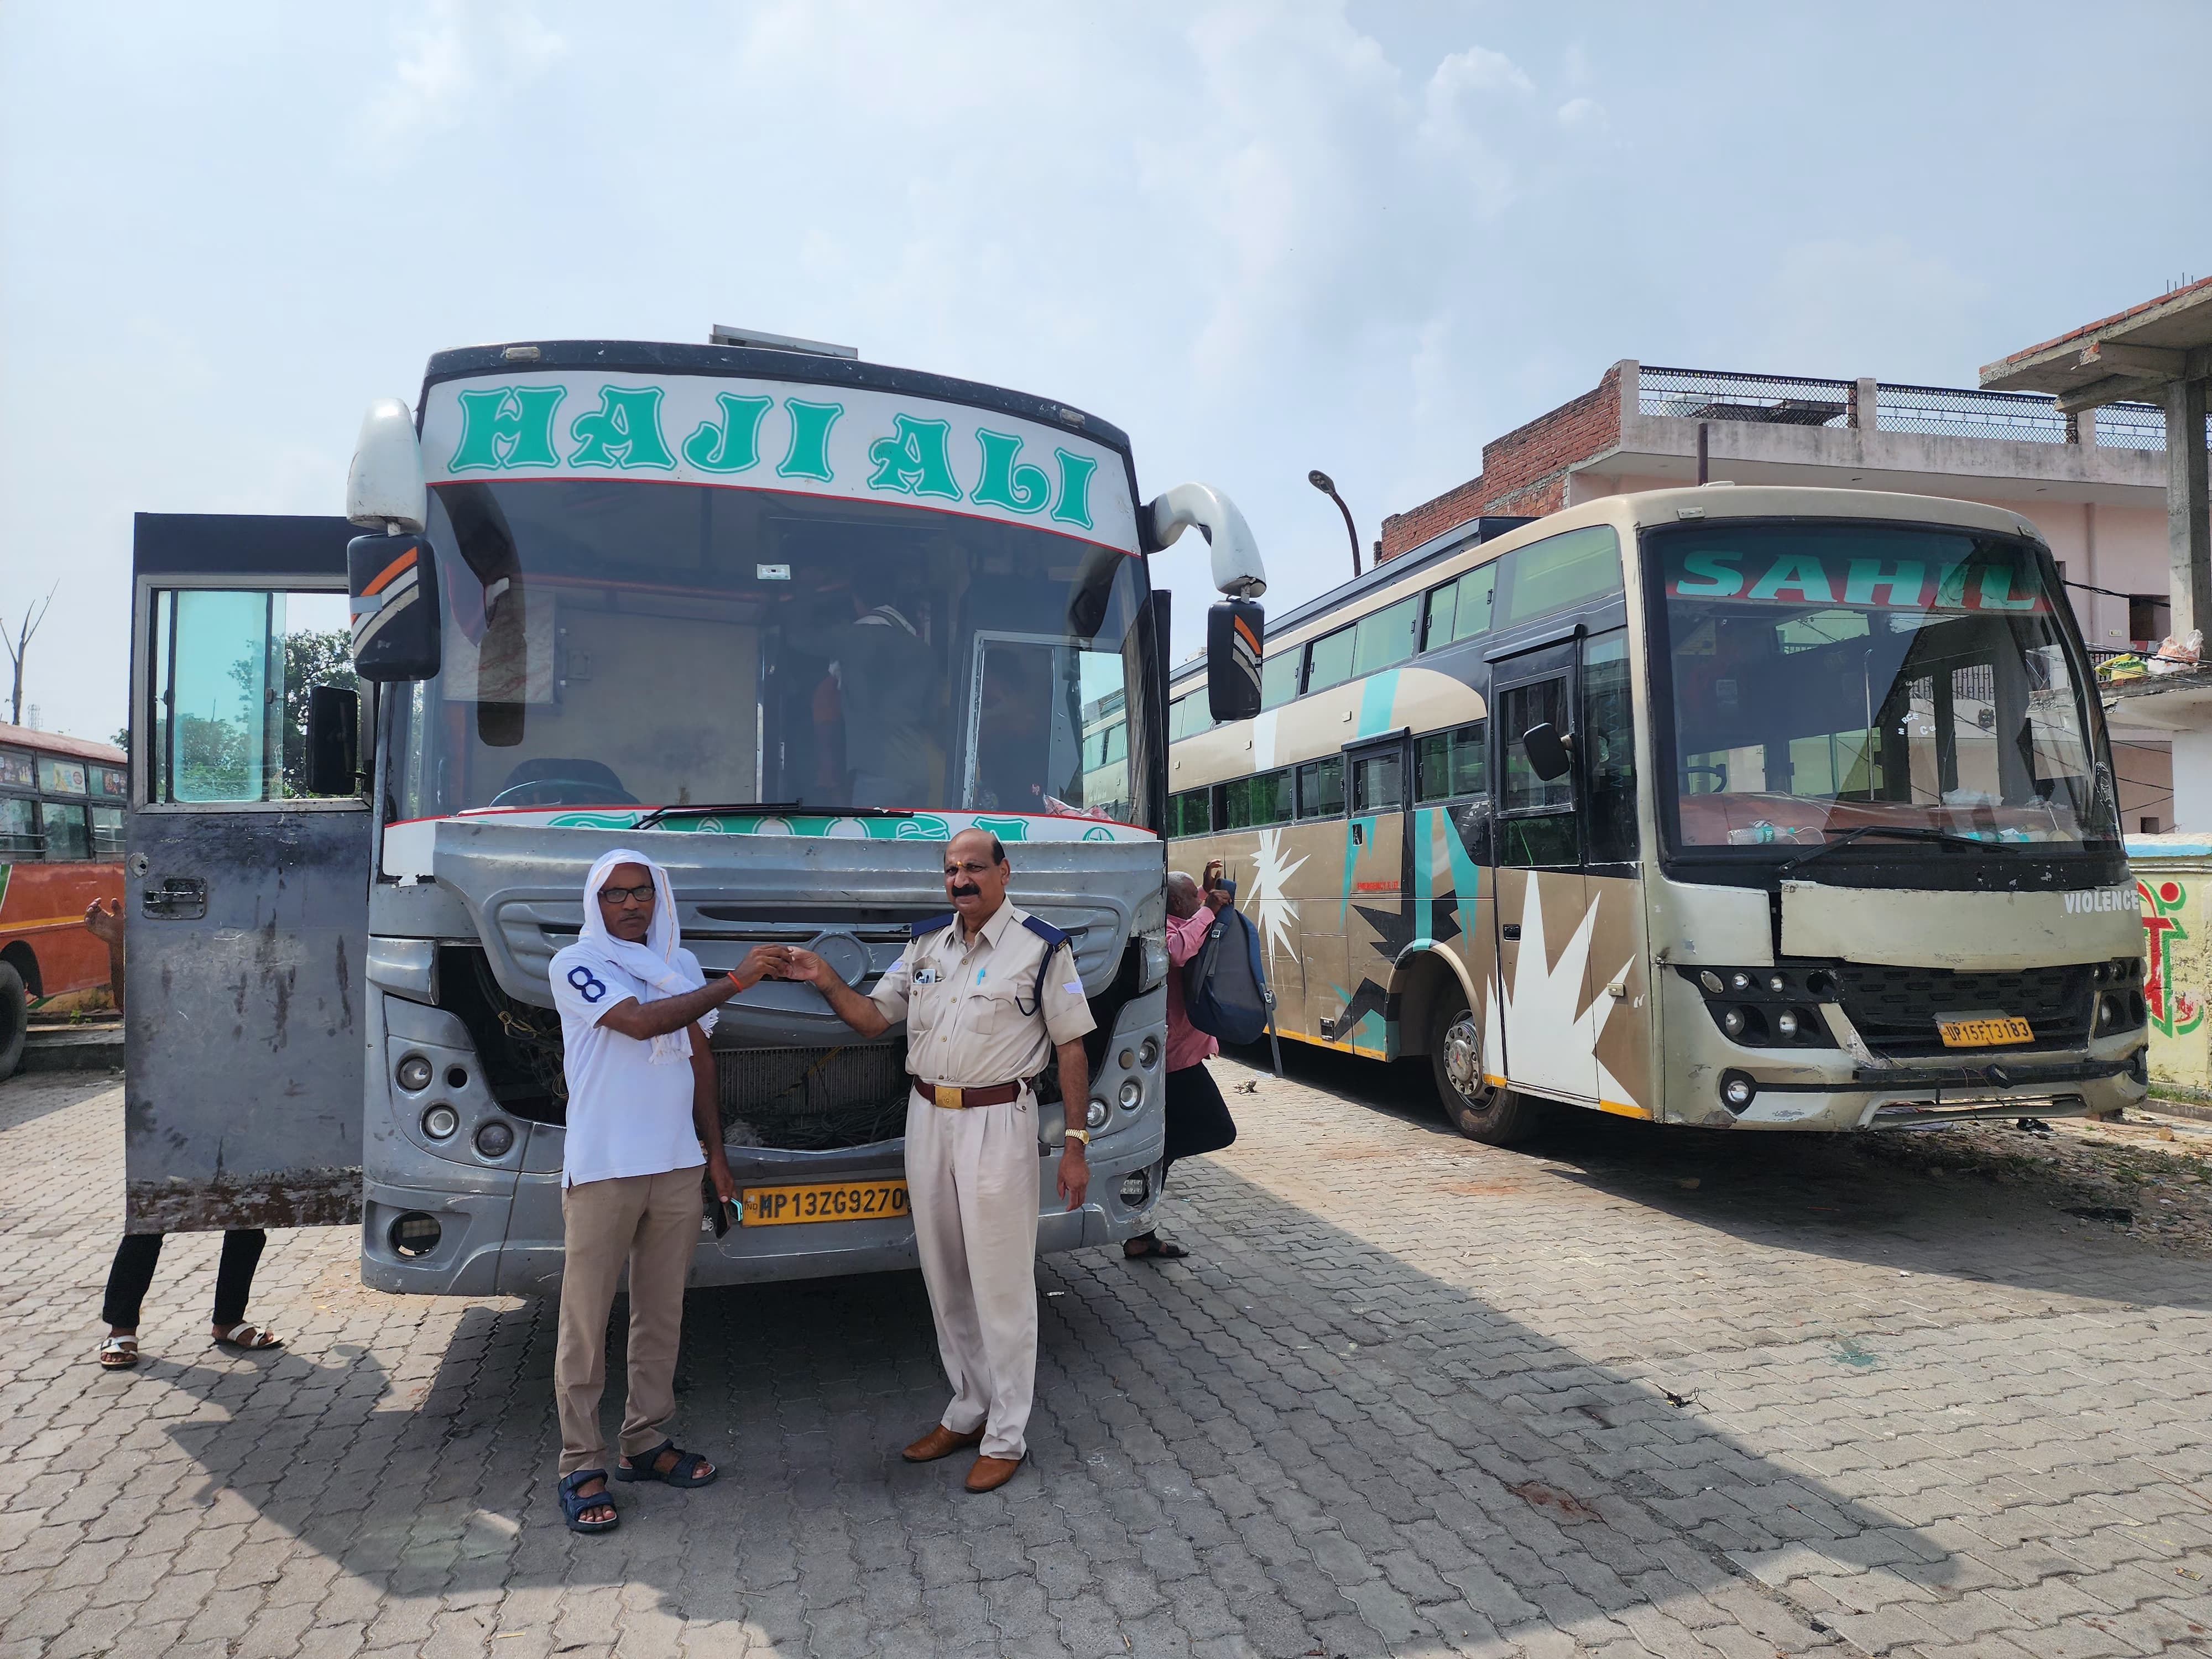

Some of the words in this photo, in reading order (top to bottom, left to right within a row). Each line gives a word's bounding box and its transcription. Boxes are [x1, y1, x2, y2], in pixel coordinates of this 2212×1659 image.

[447, 384, 844, 482] HAJI
[867, 413, 1097, 530] ALI
[1676, 551, 2036, 611] SAHIL
[2064, 890, 2139, 914] VIOLENCE
[567, 966, 606, 1003] 8
[759, 1187, 904, 1219] MP13ZG9270
